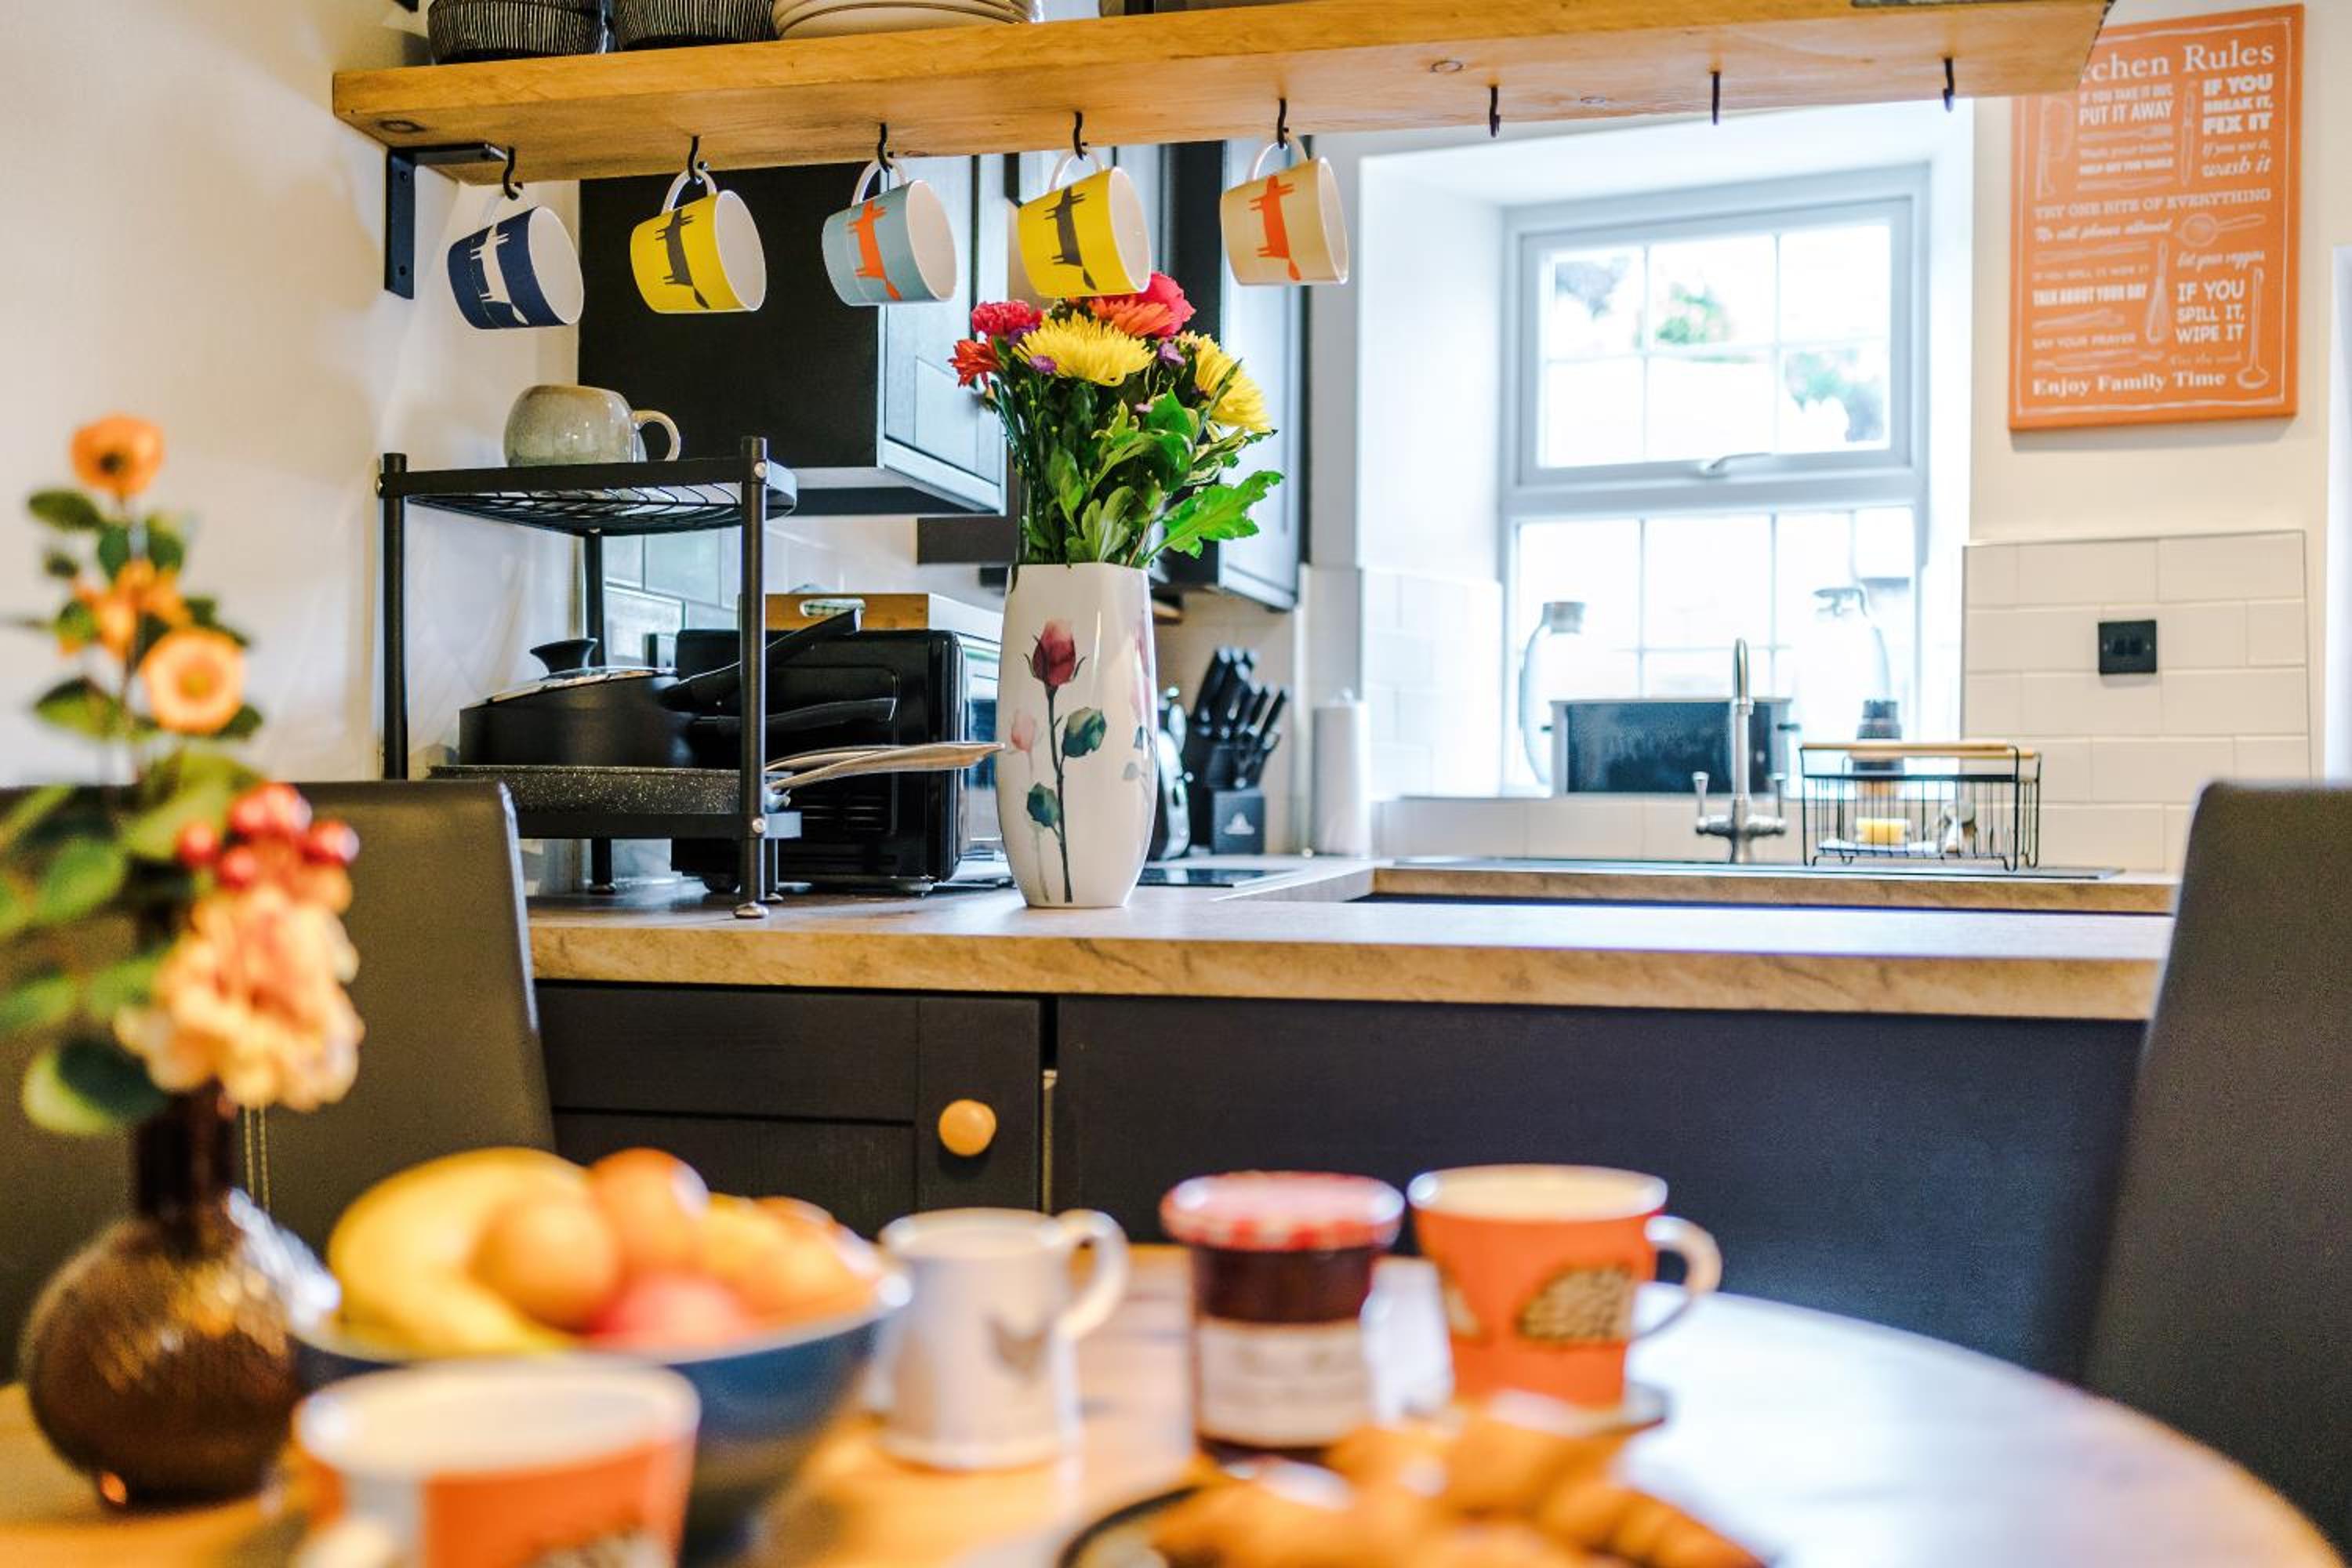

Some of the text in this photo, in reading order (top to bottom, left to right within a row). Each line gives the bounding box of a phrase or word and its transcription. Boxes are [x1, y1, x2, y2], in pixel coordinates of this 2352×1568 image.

[2183, 38, 2274, 72] Rules
[2203, 74, 2274, 97] IF YOU
[2079, 100, 2174, 125] PUT IT AWAY
[2203, 112, 2274, 135] FIX IT
[2202, 154, 2271, 176] wash it
[2033, 187, 2271, 220] TRY ONE BITE OF EVERYTHING
[2177, 278, 2245, 302] IF YOU
[2176, 306, 2220, 324] SPILL
[2176, 323, 2245, 344] WIPE IT
[2032, 370, 2226, 398] Enjoy Family Time
